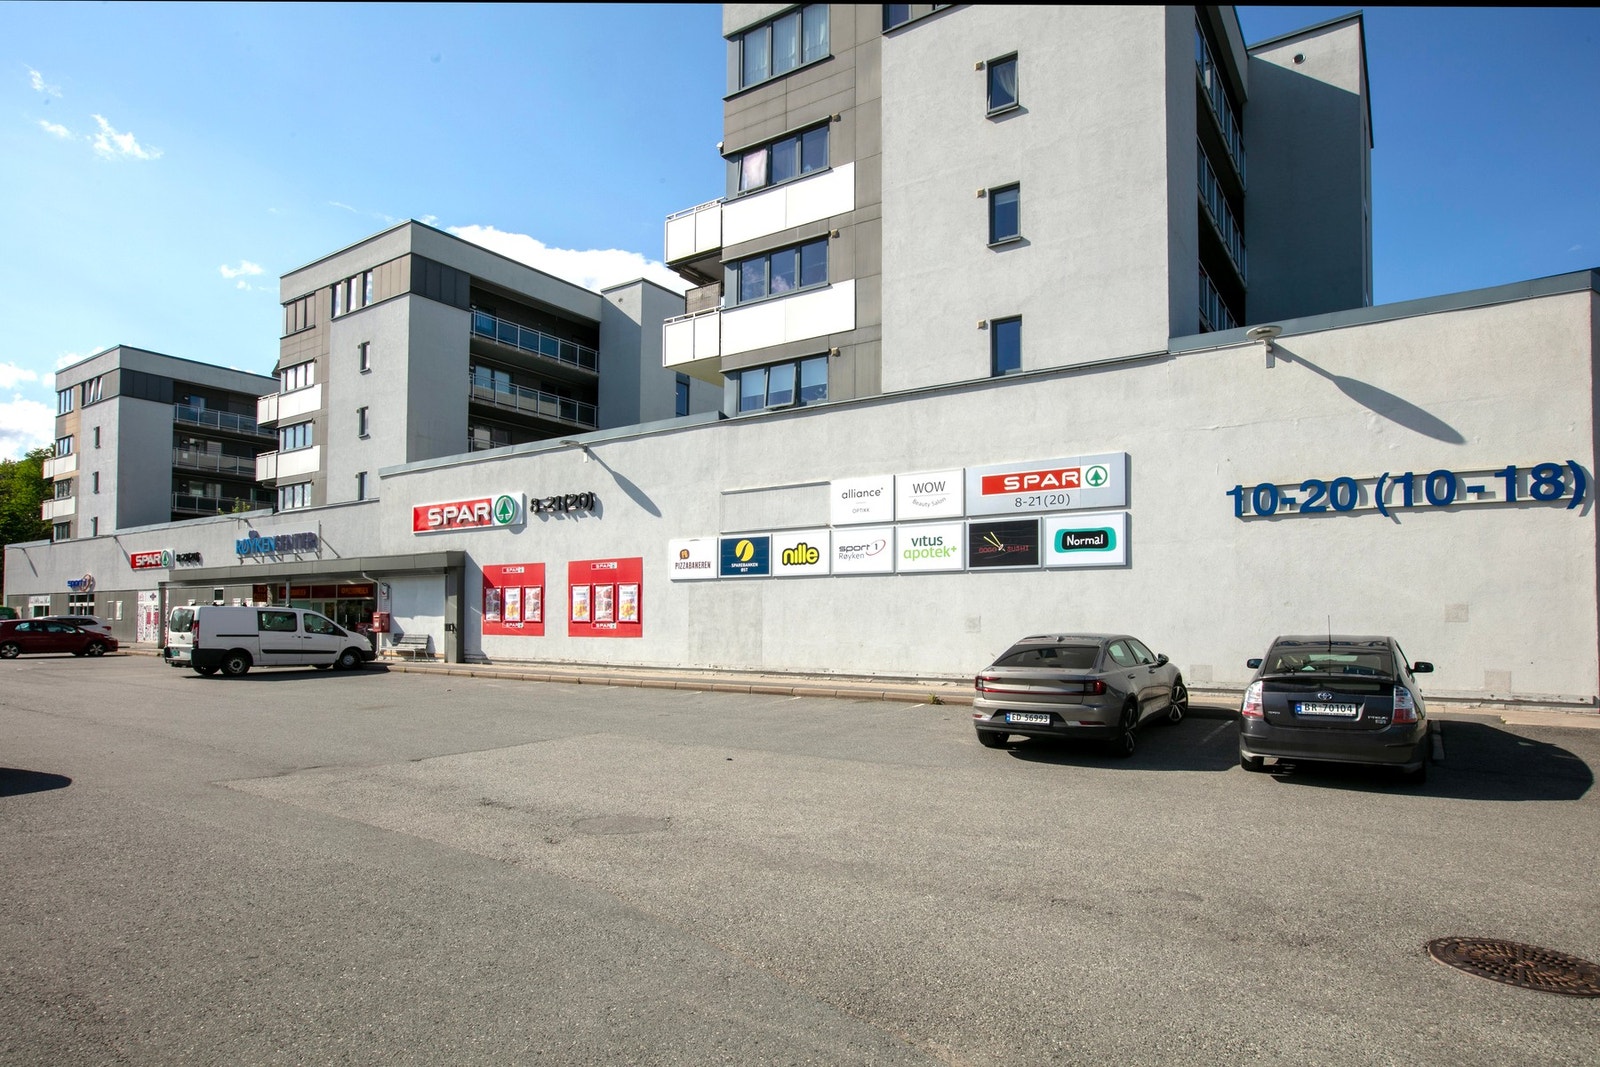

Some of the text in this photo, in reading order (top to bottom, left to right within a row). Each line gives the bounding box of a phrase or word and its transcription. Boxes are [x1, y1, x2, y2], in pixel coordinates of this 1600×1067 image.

[912, 481, 946, 494] WOW
[1003, 471, 1080, 492] SPAR
[841, 488, 882, 500] alliance
[1225, 460, 1587, 518] 10-20 (10-18)
[530, 491, 594, 514] 8-21(20)
[911, 496, 947, 508] Beauty Salon
[1014, 493, 1071, 508] 8-21(20)
[427, 502, 491, 527] SPAR
[911, 535, 944, 547] vitus
[1066, 533, 1104, 547] Normal
[782, 542, 820, 566] nille
[838, 543, 871, 553] sport
[135, 553, 161, 567] SPAR
[838, 552, 865, 561] Røyken
[674, 560, 712, 570] PIZZABAKEREN
[1304, 703, 1353, 713] BR 70104
[1011, 713, 1048, 723] ED 56993
